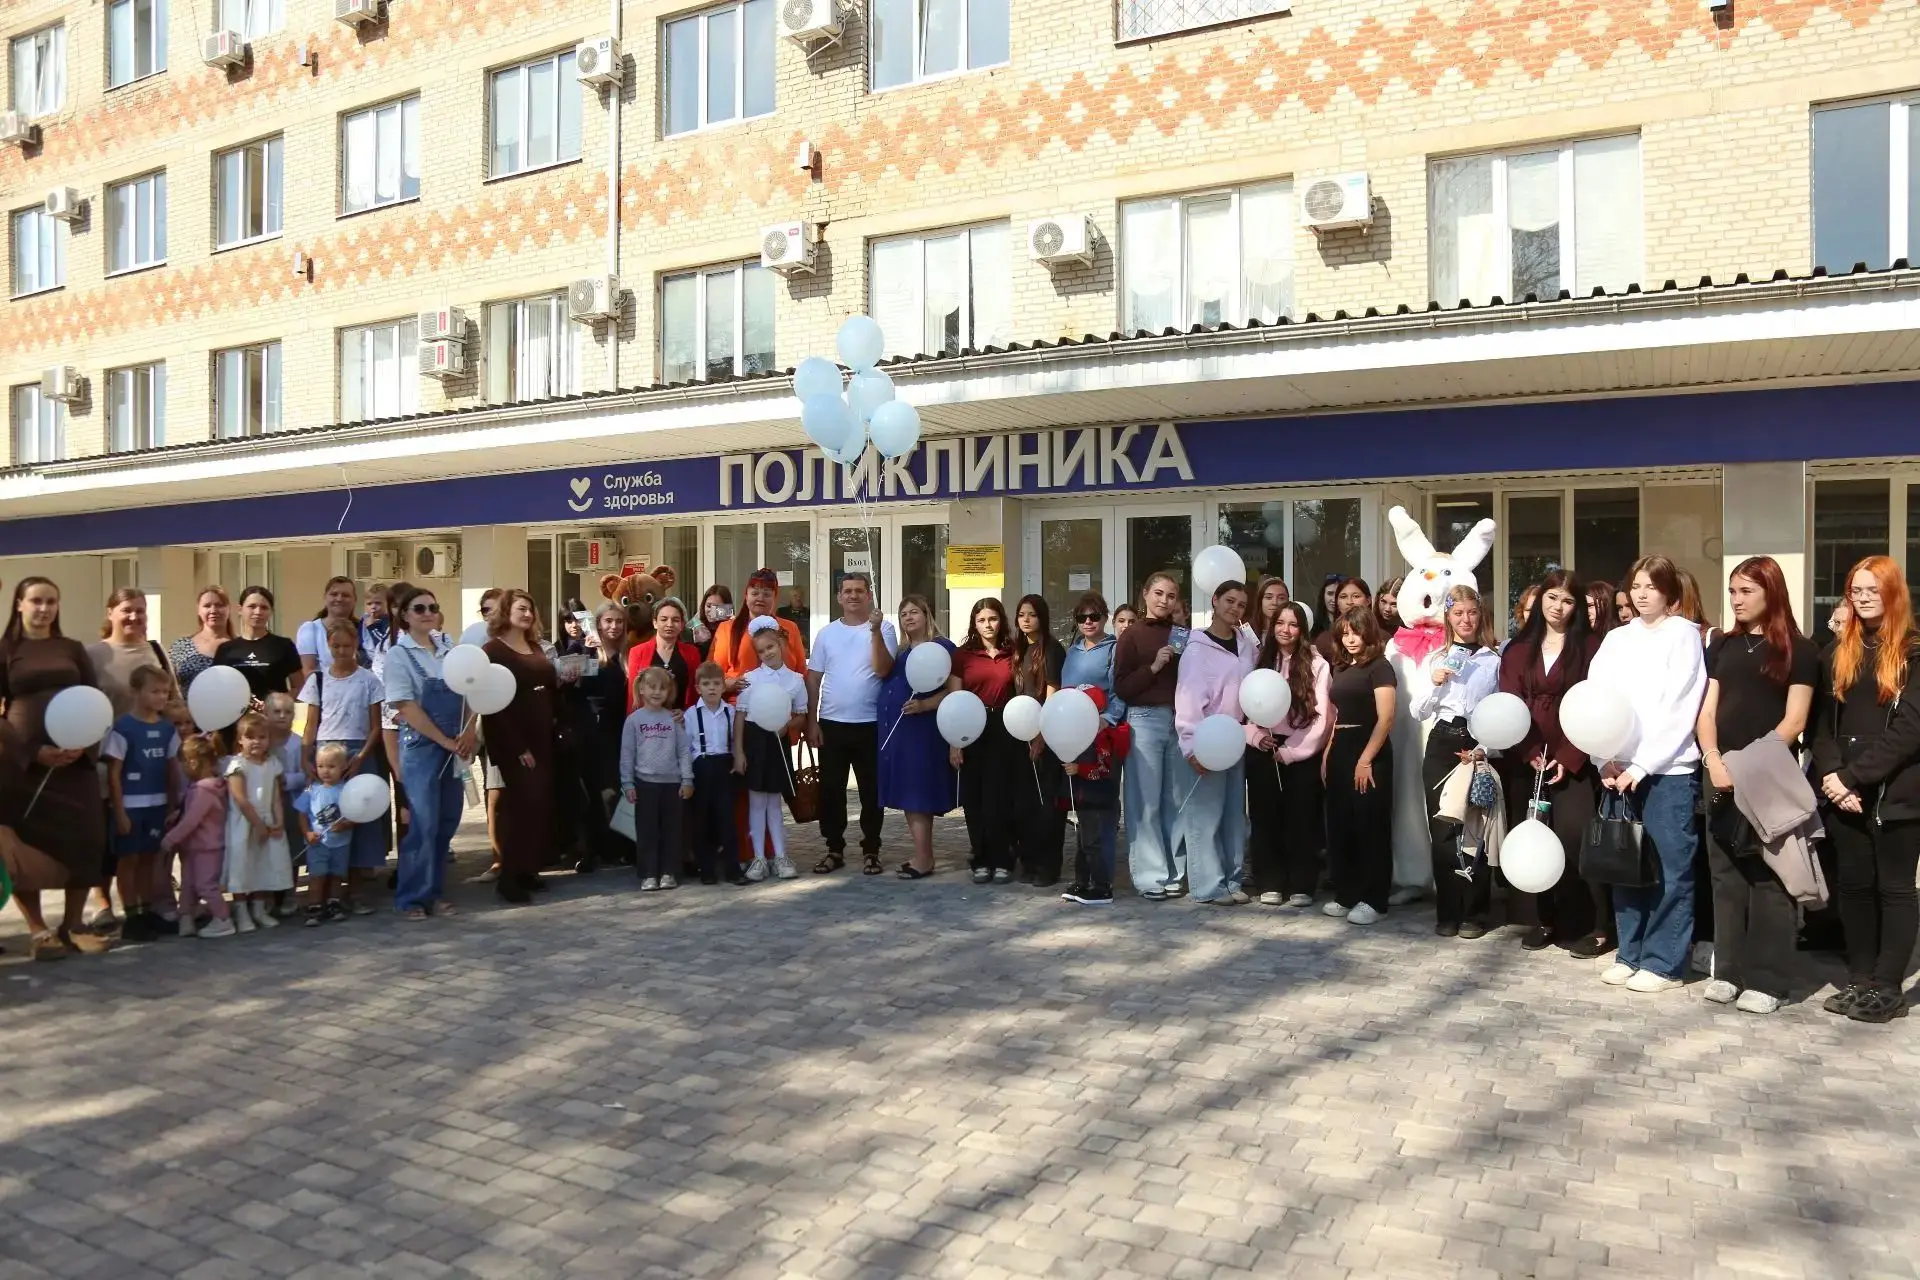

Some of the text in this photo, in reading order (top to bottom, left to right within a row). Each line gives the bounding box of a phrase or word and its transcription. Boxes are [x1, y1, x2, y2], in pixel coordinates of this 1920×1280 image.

[720, 423, 1195, 507] ПОЛИКЛИНИКА
[603, 470, 662, 492] Служба
[603, 491, 674, 510] здоровья
[142, 747, 165, 759] YES
